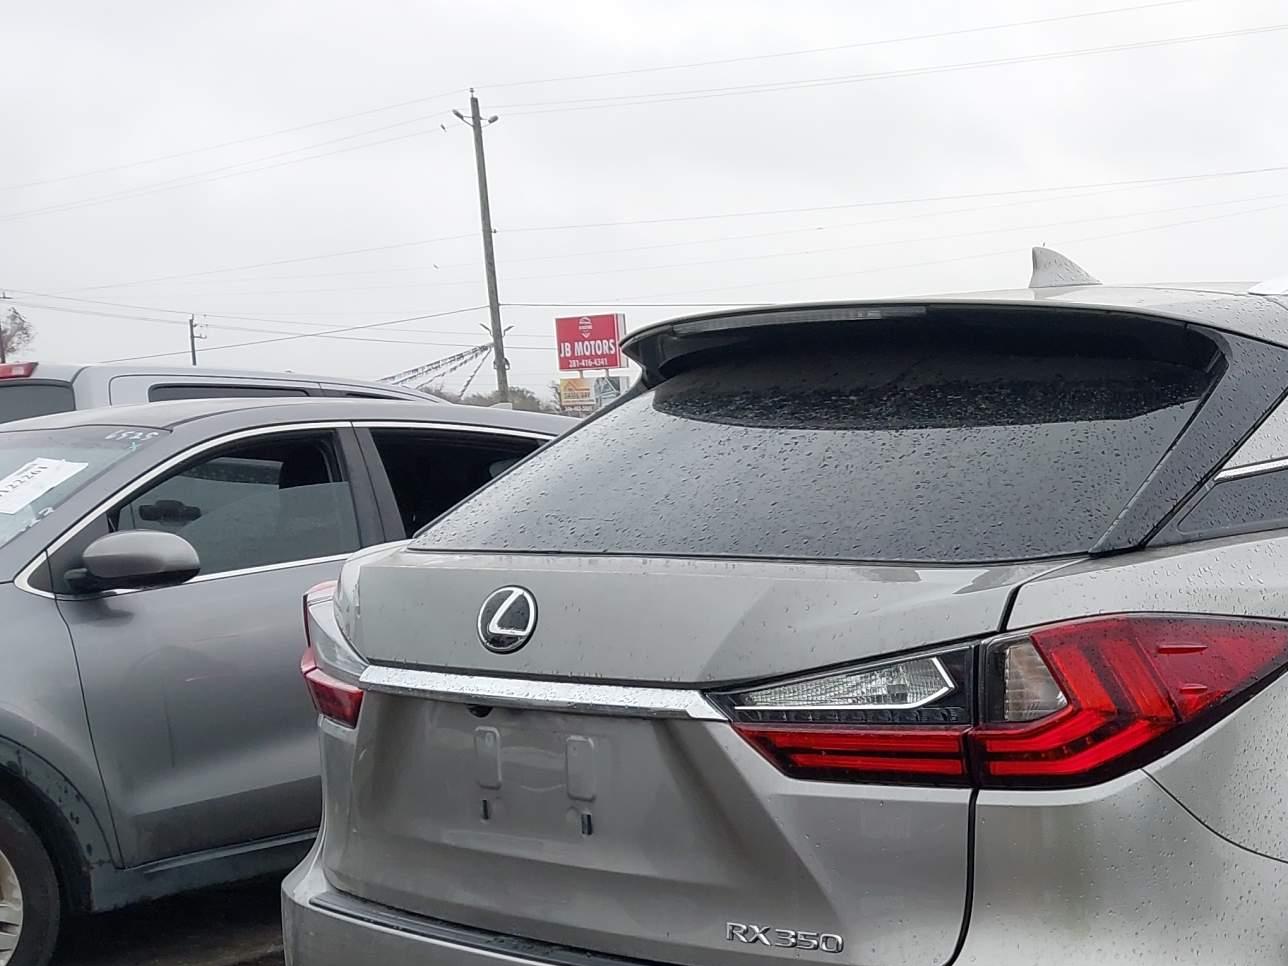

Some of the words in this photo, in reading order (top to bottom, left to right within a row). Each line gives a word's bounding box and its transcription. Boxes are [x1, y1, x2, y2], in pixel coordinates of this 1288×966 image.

[560, 342, 571, 357] JB
[575, 339, 616, 356] MOTORS
[726, 921, 772, 946] RX
[775, 928, 845, 953] 350
